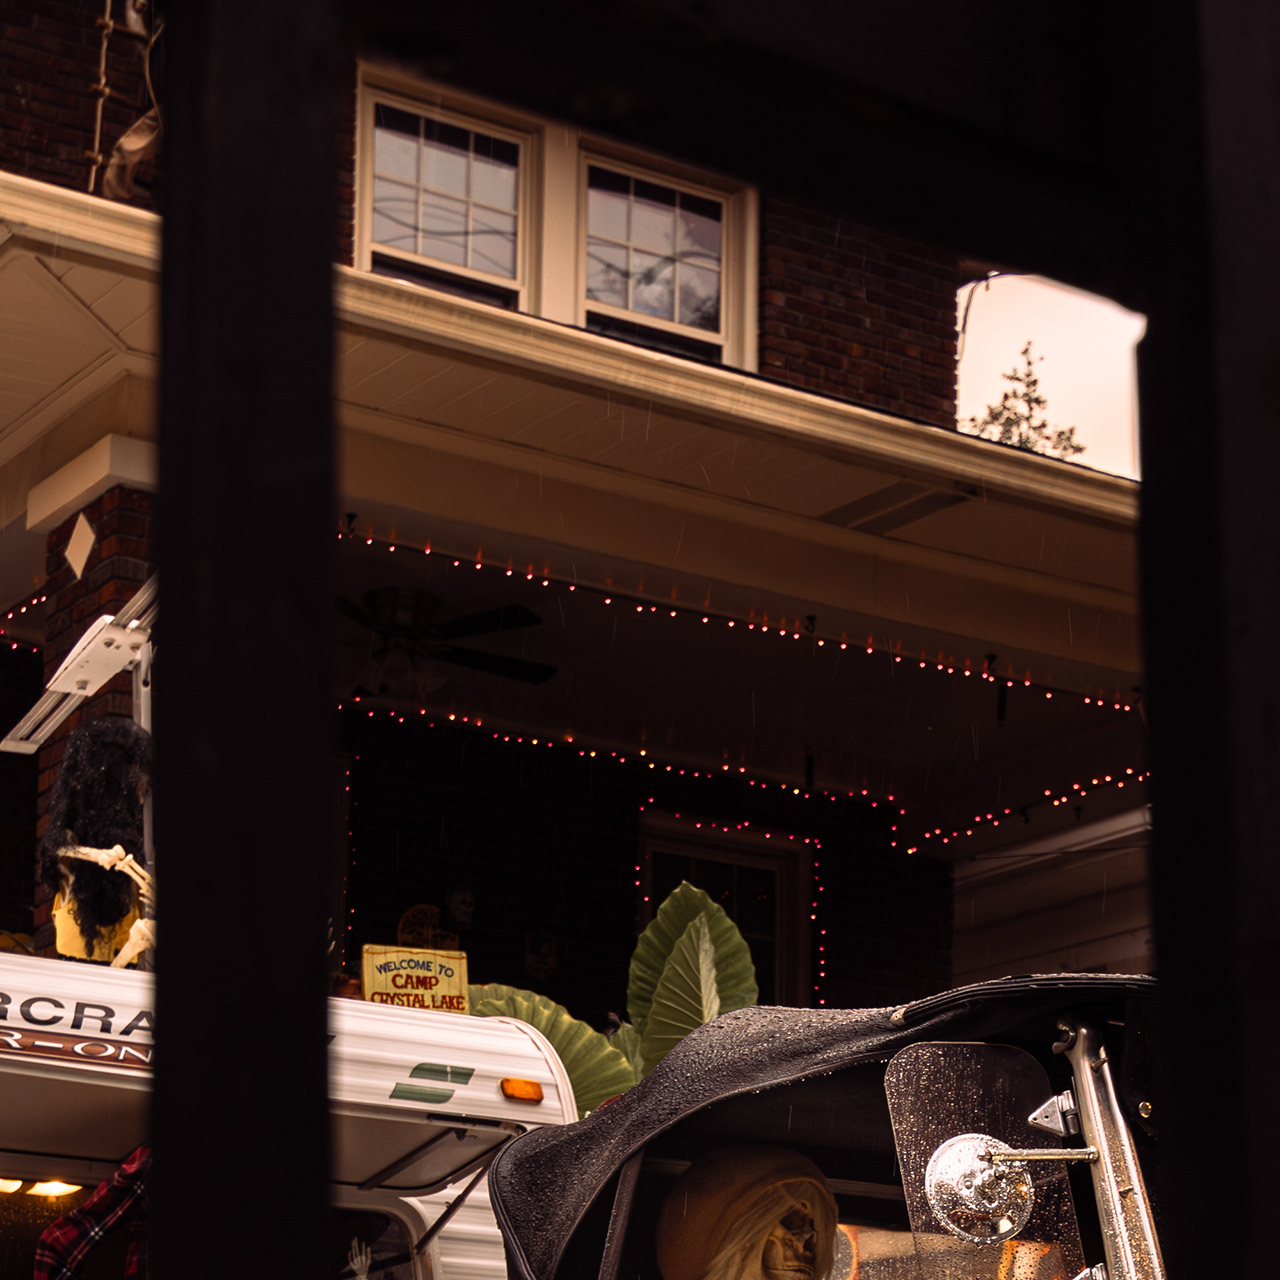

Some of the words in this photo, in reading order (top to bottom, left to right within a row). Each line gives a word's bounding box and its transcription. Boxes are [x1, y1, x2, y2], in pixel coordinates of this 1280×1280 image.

[375, 958, 433, 975] WELCOME
[438, 963, 454, 978] TO
[391, 973, 439, 990] CAMP
[370, 991, 430, 1009] CRYSTAL
[431, 994, 465, 1011] LAKE
